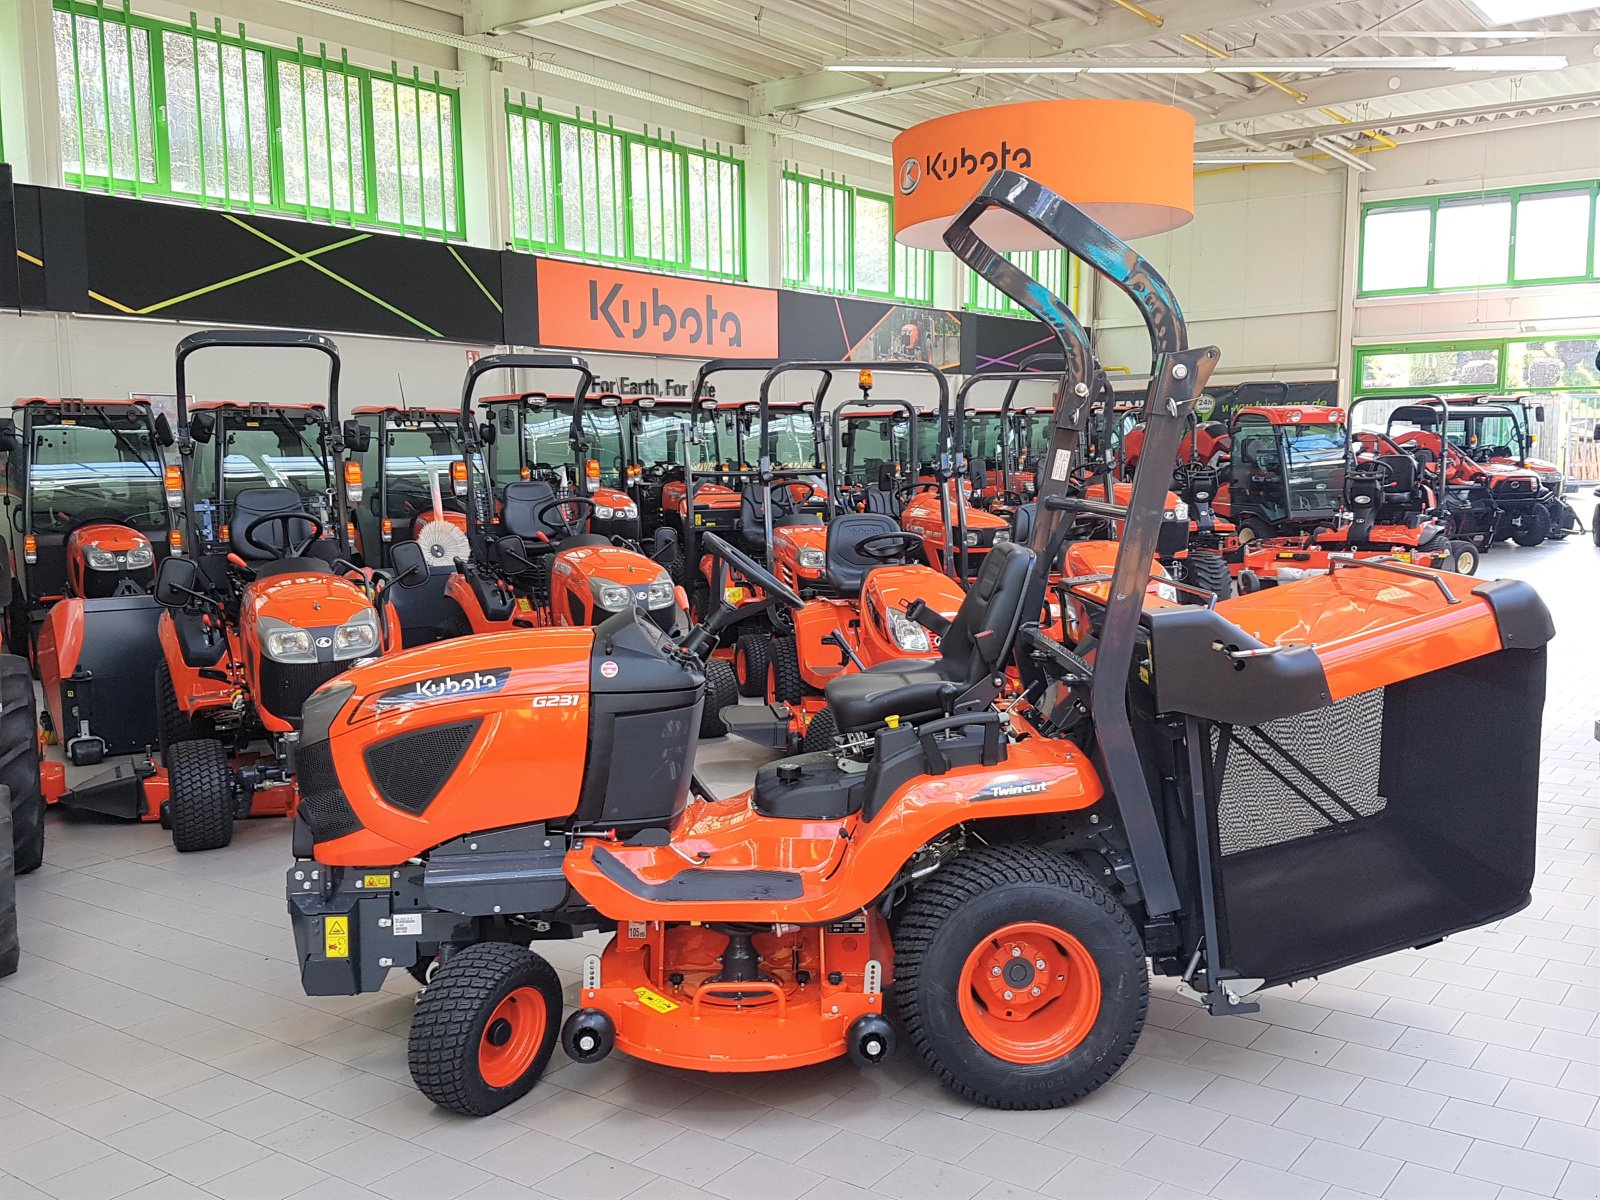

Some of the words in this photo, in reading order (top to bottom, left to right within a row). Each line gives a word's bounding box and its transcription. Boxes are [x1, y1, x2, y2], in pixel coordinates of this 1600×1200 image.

[926, 141, 1032, 181] Kubota
[589, 279, 742, 348] Kubota
[591, 375, 616, 394] For
[666, 379, 688, 397] For
[416, 672, 497, 697] Kubota
[532, 695, 580, 708] G231
